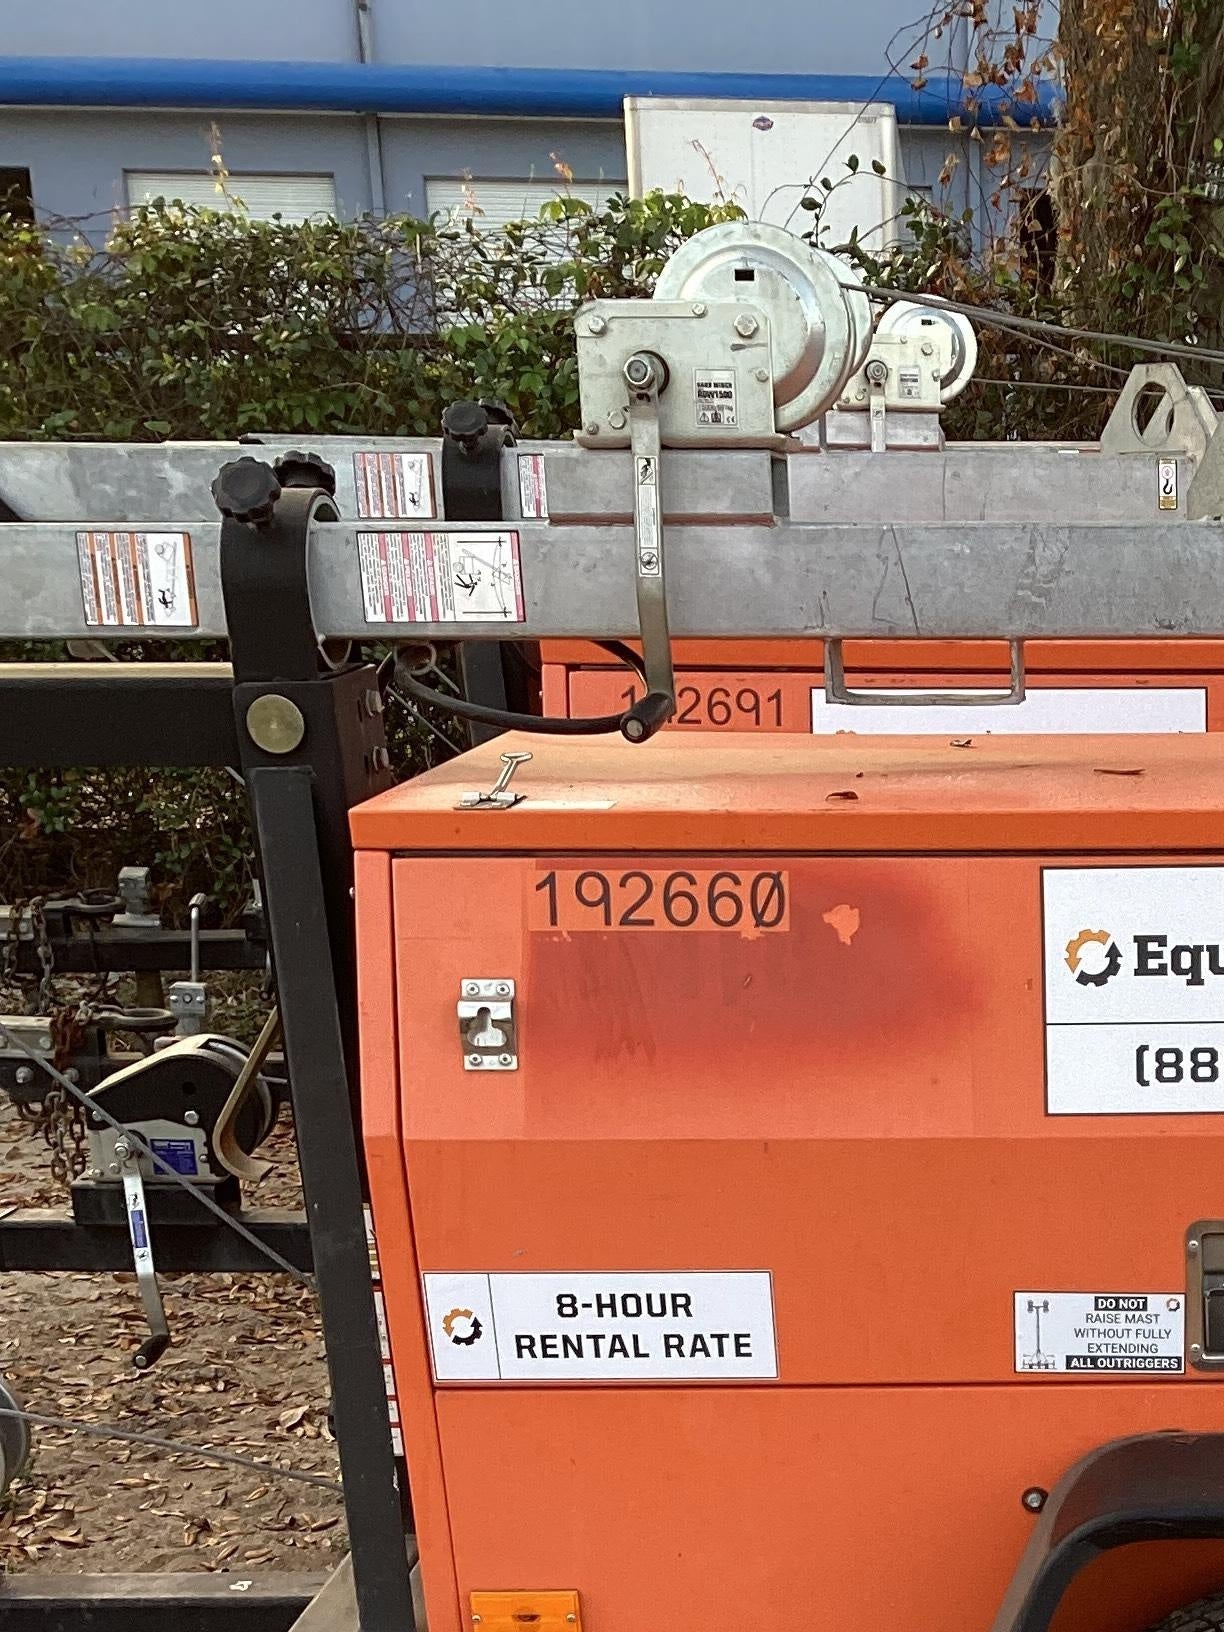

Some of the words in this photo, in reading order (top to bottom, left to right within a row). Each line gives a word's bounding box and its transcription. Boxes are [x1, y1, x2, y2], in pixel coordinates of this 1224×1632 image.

[621, 685, 783, 727] 12691
[556, 1292, 693, 1318] 8-HOUR
[1097, 1298, 1116, 1310] DO
[1119, 1298, 1146, 1310] NOT
[1085, 1313, 1121, 1324] RAISE
[1124, 1313, 1160, 1324] MAST
[1073, 1327, 1132, 1338] WITHOUT
[1135, 1328, 1172, 1339] FULLY
[514, 1333, 650, 1360] RENTAL
[663, 1332, 753, 1358] RATE
[1087, 1342, 1159, 1353] EXTENDING
[1070, 1357, 1094, 1368] ALL
[1096, 1357, 1179, 1369] OUTRIGGERS
